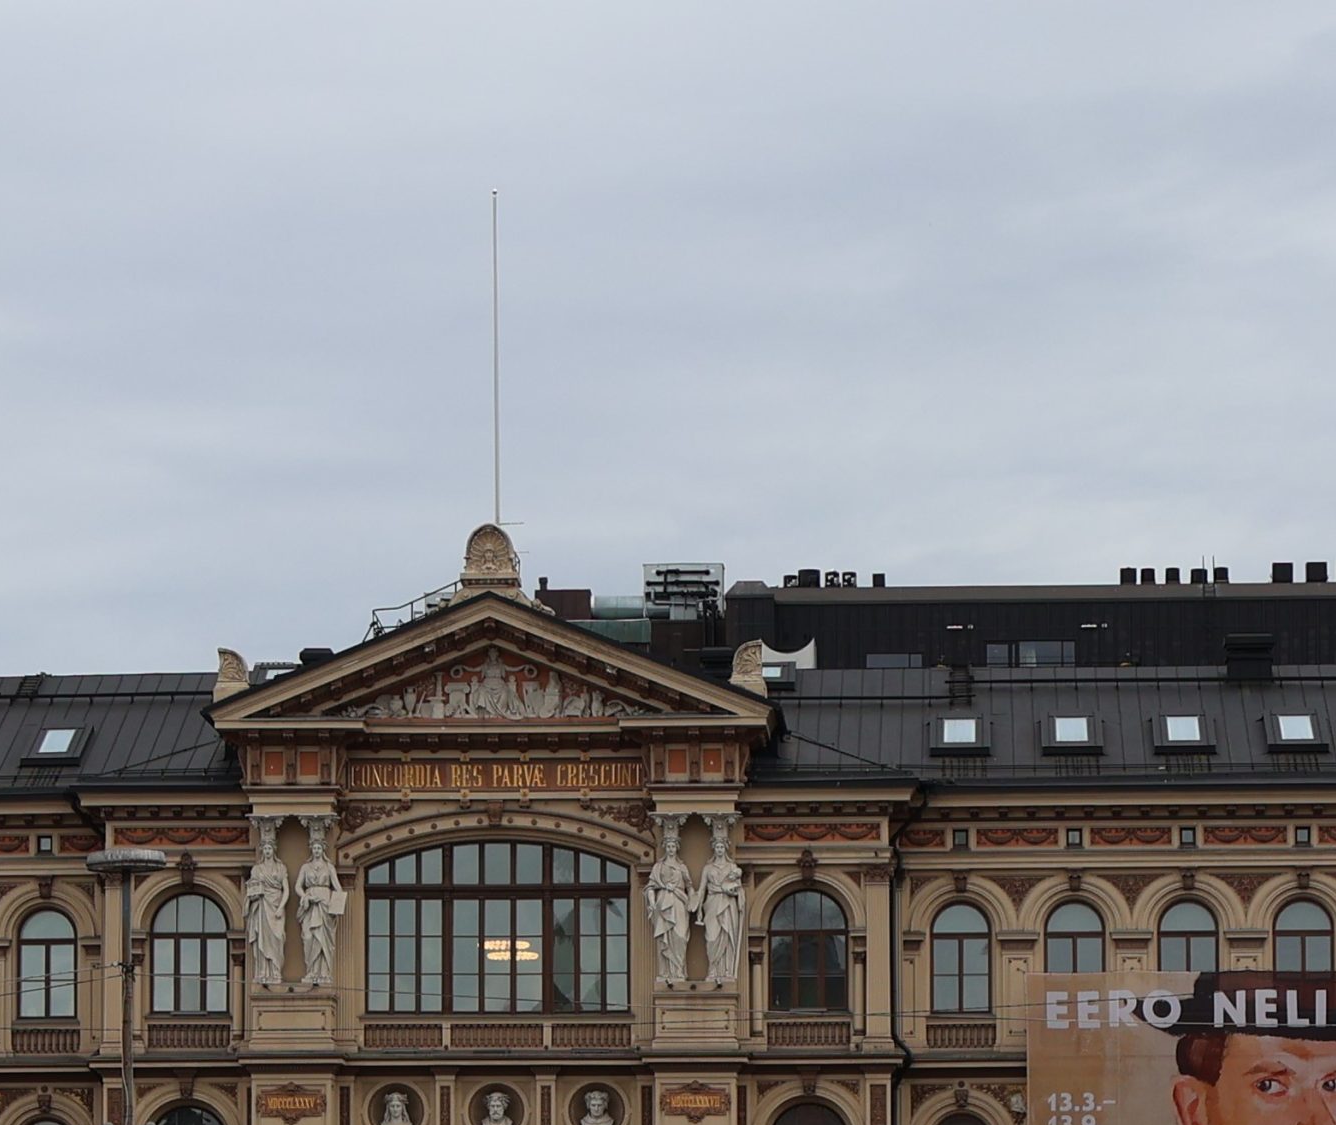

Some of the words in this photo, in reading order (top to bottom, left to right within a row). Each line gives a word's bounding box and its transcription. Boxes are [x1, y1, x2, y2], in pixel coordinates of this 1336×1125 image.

[351, 763, 442, 787] CONCORDIA
[451, 763, 482, 786] RES
[557, 762, 644, 786] CRESCUNT
[1046, 990, 1182, 1029] EERO
